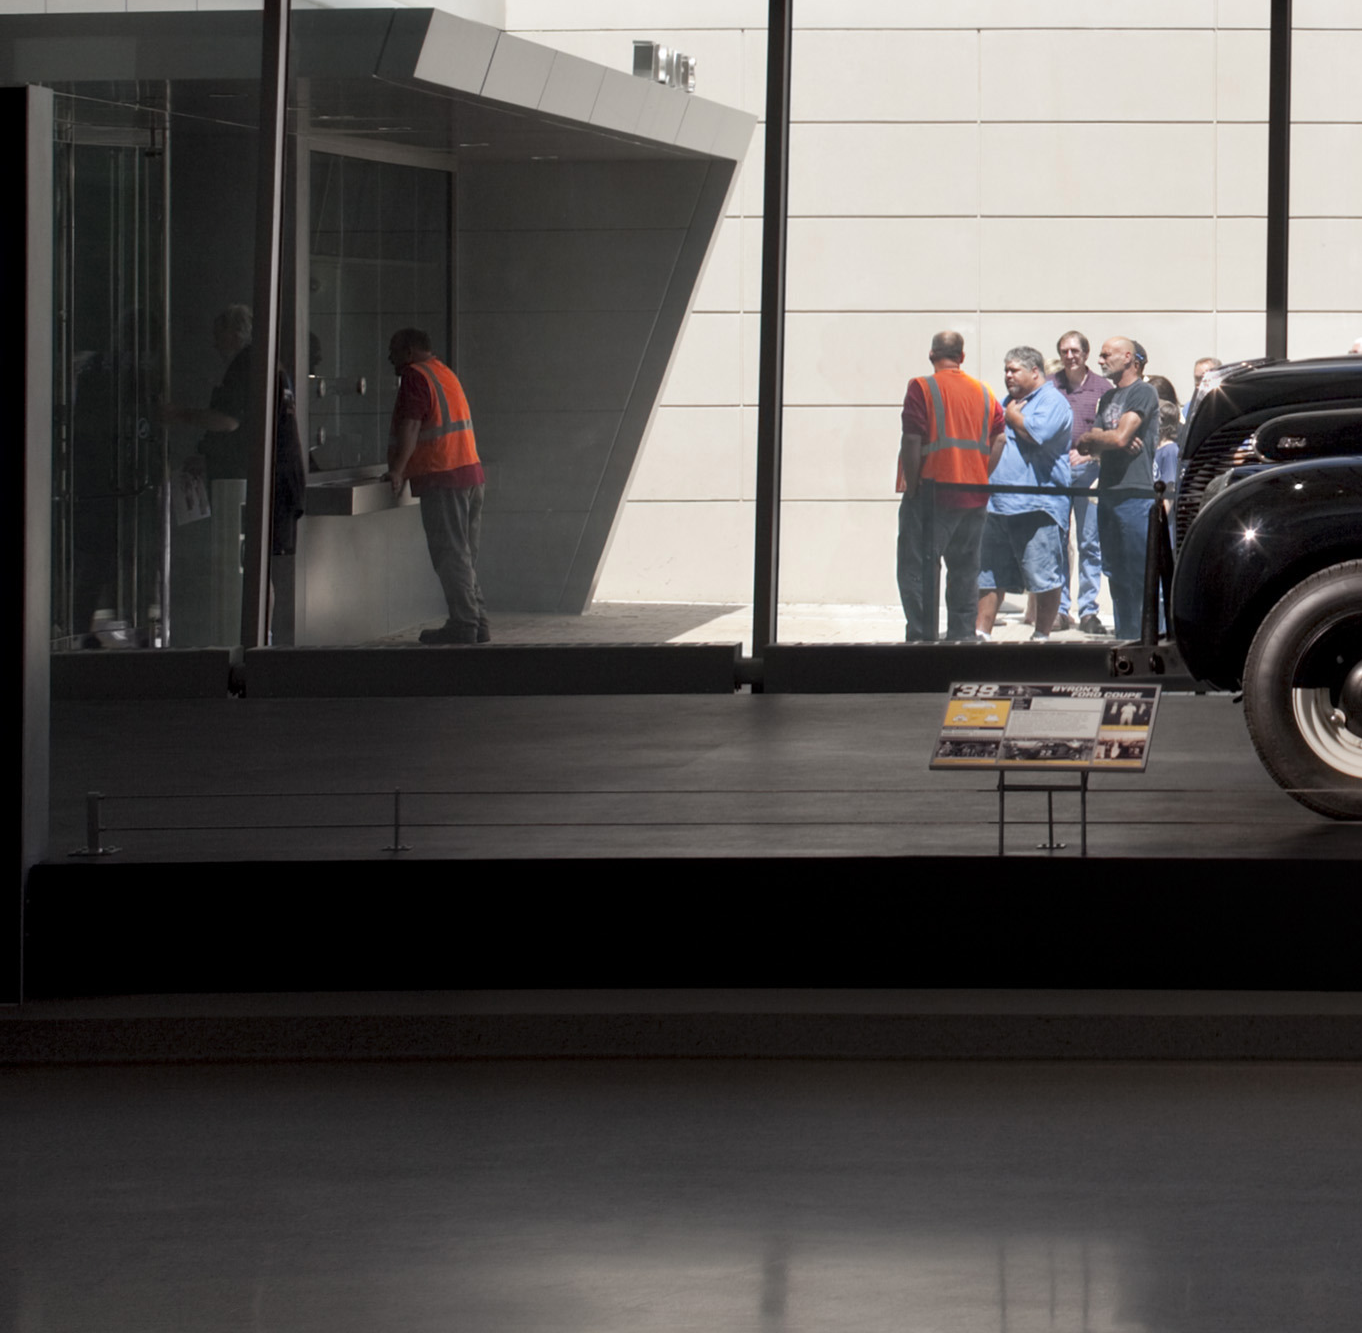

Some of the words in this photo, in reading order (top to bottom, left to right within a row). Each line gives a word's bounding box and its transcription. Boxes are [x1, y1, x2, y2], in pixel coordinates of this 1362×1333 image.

[1051, 685, 1102, 693] BYRON'S
[1071, 691, 1102, 699] FORD
[1103, 691, 1143, 699] COUPE
